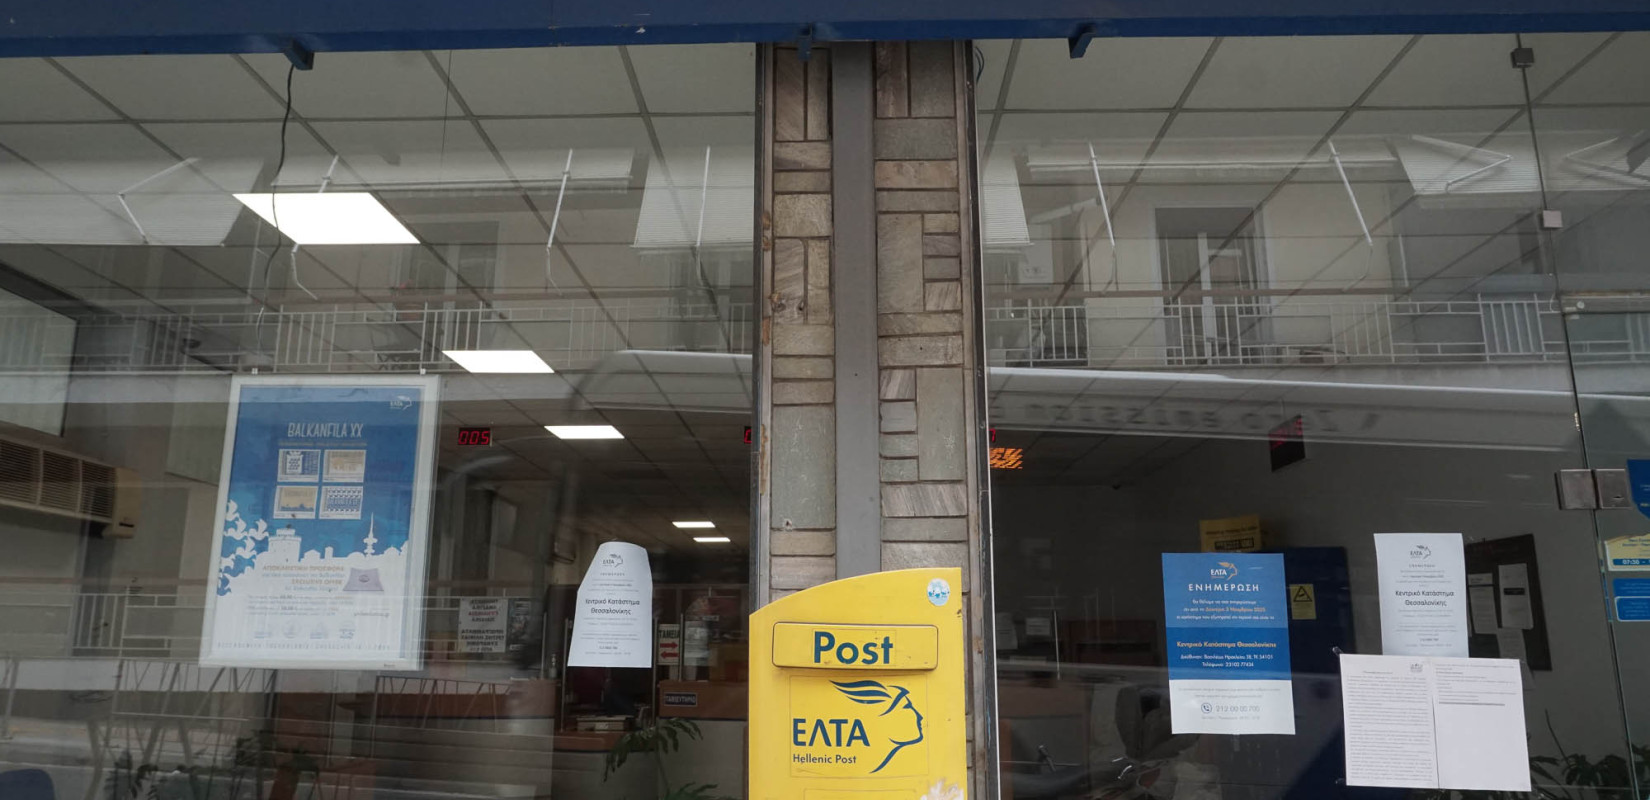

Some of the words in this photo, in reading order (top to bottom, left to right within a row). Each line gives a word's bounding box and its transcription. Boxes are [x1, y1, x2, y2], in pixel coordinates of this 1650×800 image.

[287, 422, 347, 438] BALKANFILA
[350, 423, 364, 438] XX
[458, 430, 489, 445] 005
[1188, 584, 1260, 592] ΕΝΗΜΕΡΩΣΗ
[1421, 590, 1455, 598] Κατάστημα
[608, 598, 641, 608] Κατάστημα
[1405, 599, 1447, 608] Θεσσαλονίκης
[814, 630, 894, 665] Post
[792, 718, 871, 748] ΕΛΤΑ
[792, 753, 833, 764] Hellenic
[835, 754, 857, 765] Post
